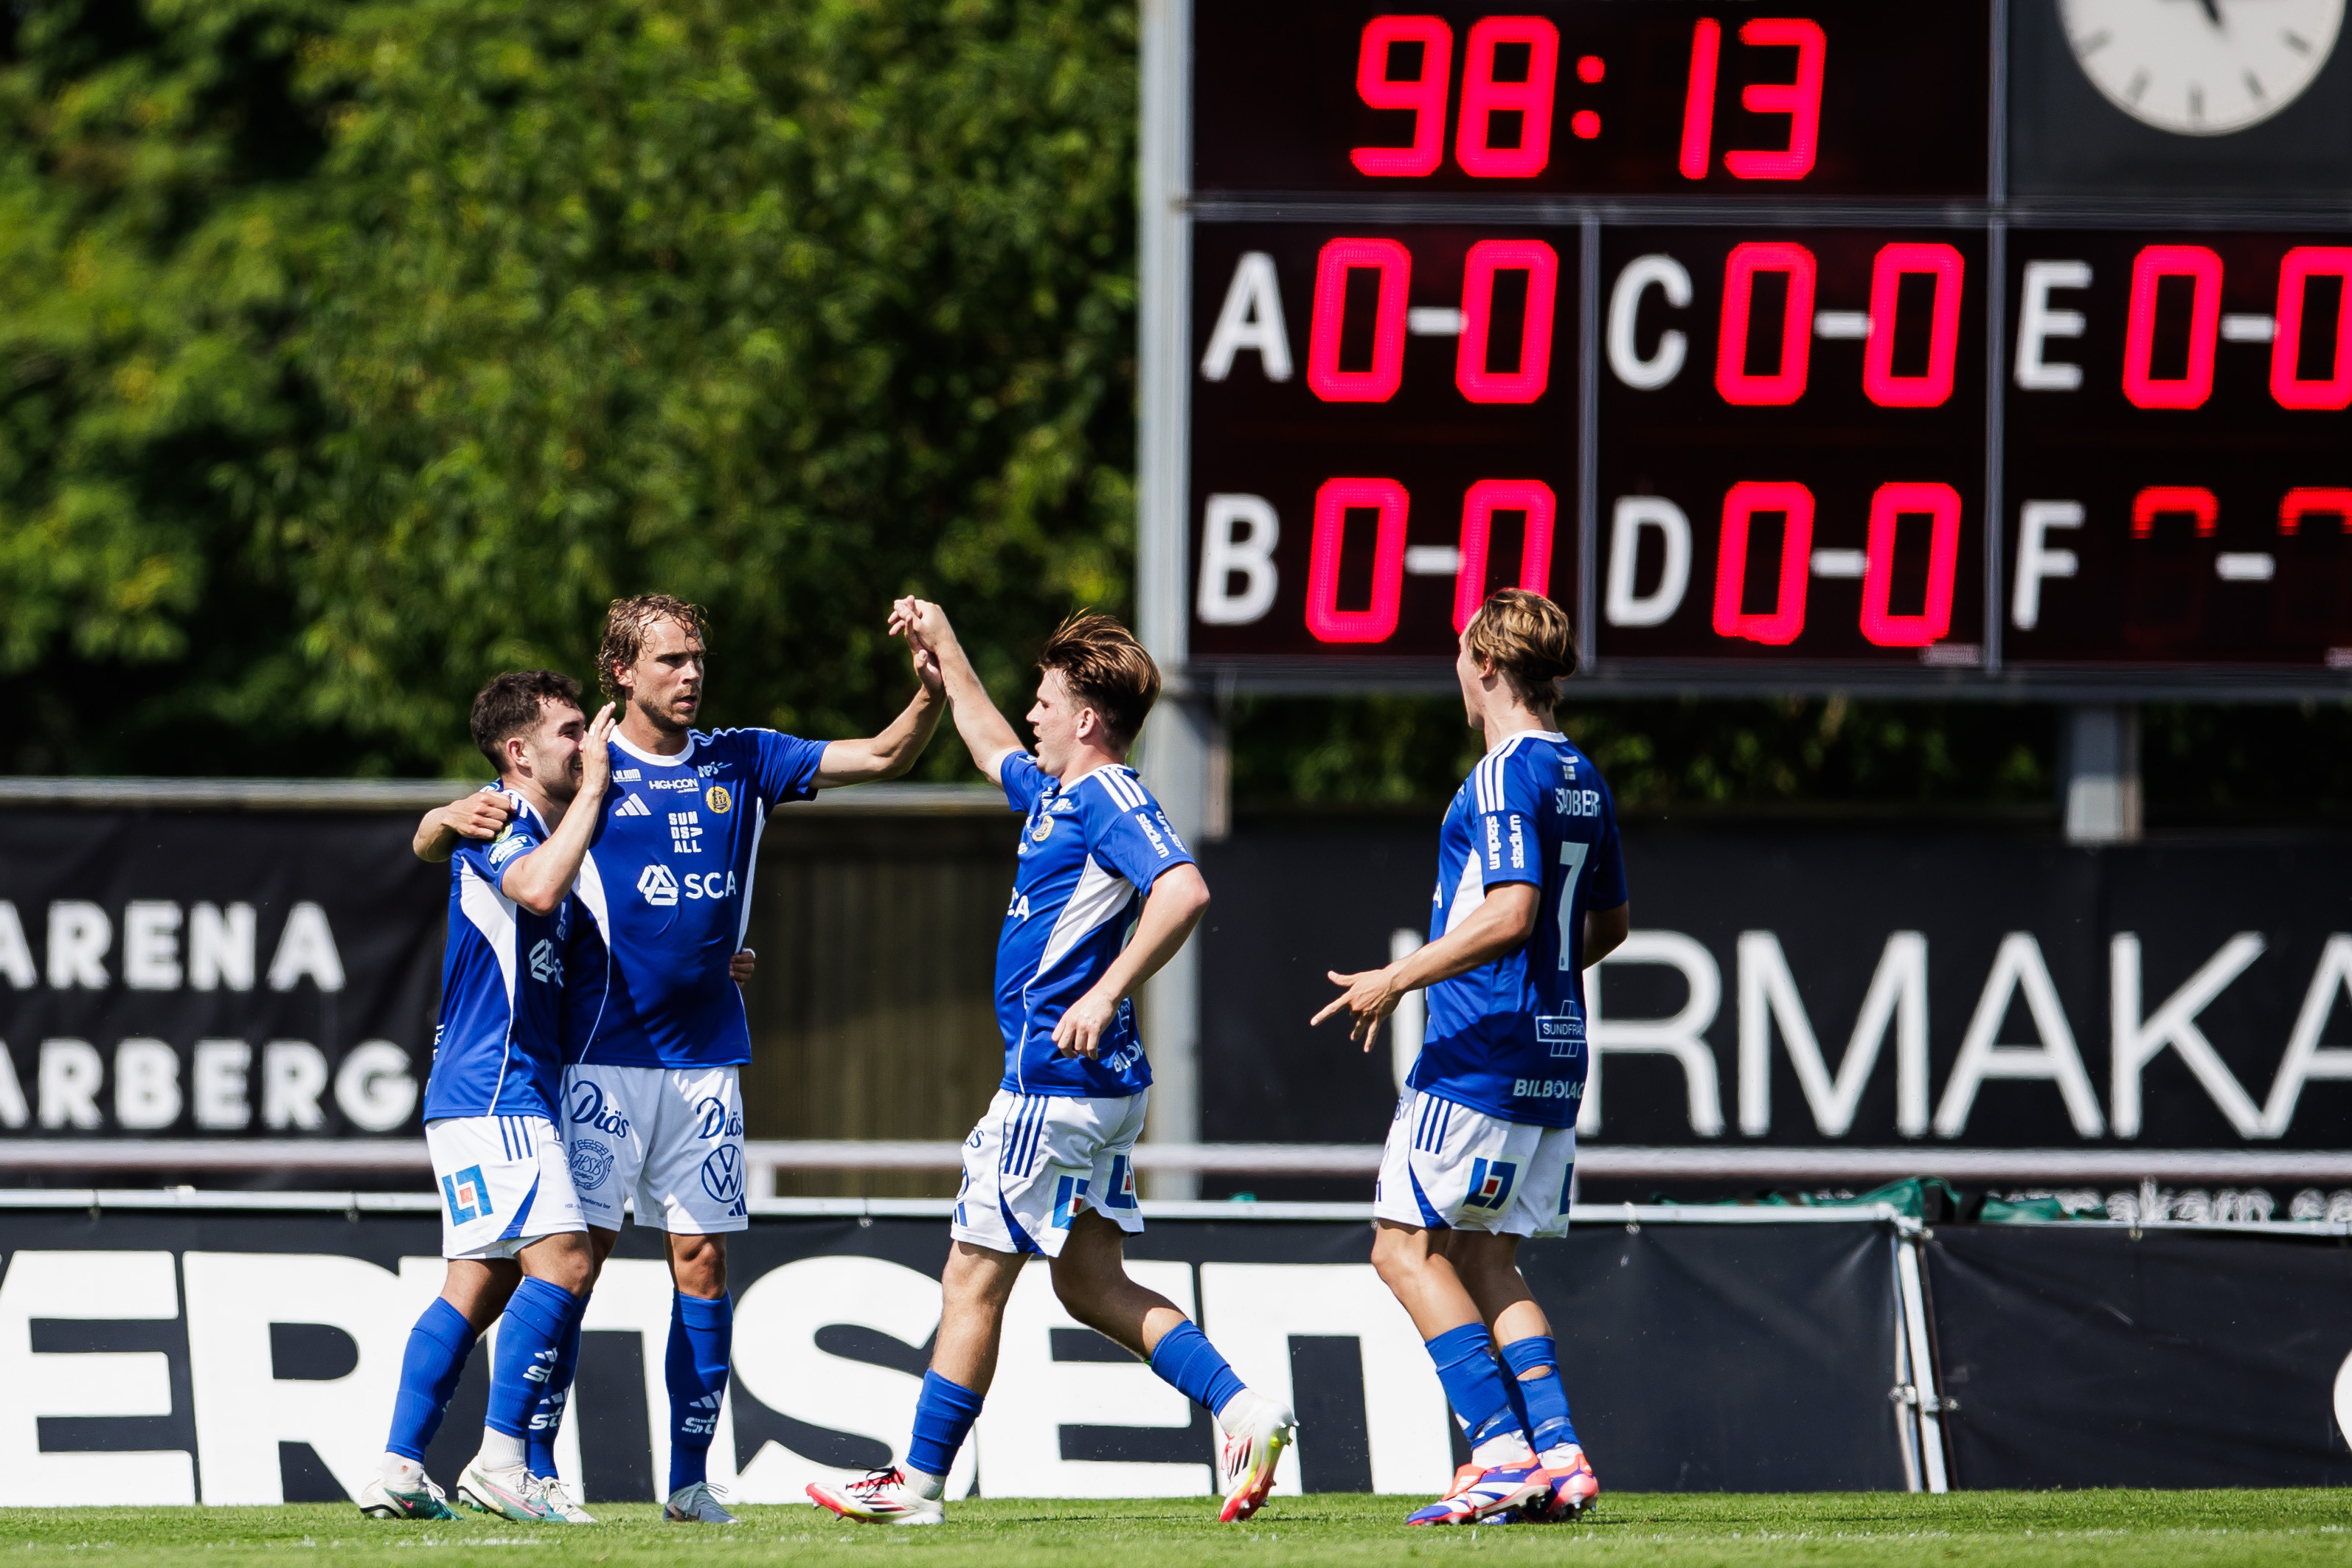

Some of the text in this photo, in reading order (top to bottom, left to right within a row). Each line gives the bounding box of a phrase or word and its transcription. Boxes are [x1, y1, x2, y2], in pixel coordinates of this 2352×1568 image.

[1201, 251, 1292, 381] A
[1607, 254, 1693, 389] C
[2015, 260, 2092, 391] E
[1197, 493, 1280, 625] B
[1606, 496, 1692, 628] D
[2012, 501, 2085, 629] F
[648, 778, 699, 790] HIGHCON
[668, 811, 698, 825] SUN
[674, 840, 702, 853] ALL
[1135, 813, 1170, 859] stadium
[1485, 815, 1502, 871] stadium
[1508, 814, 1525, 870] stadium
[684, 870, 737, 900] SCA
[1558, 842, 1589, 971] 7
[570, 1080, 630, 1139] Diös
